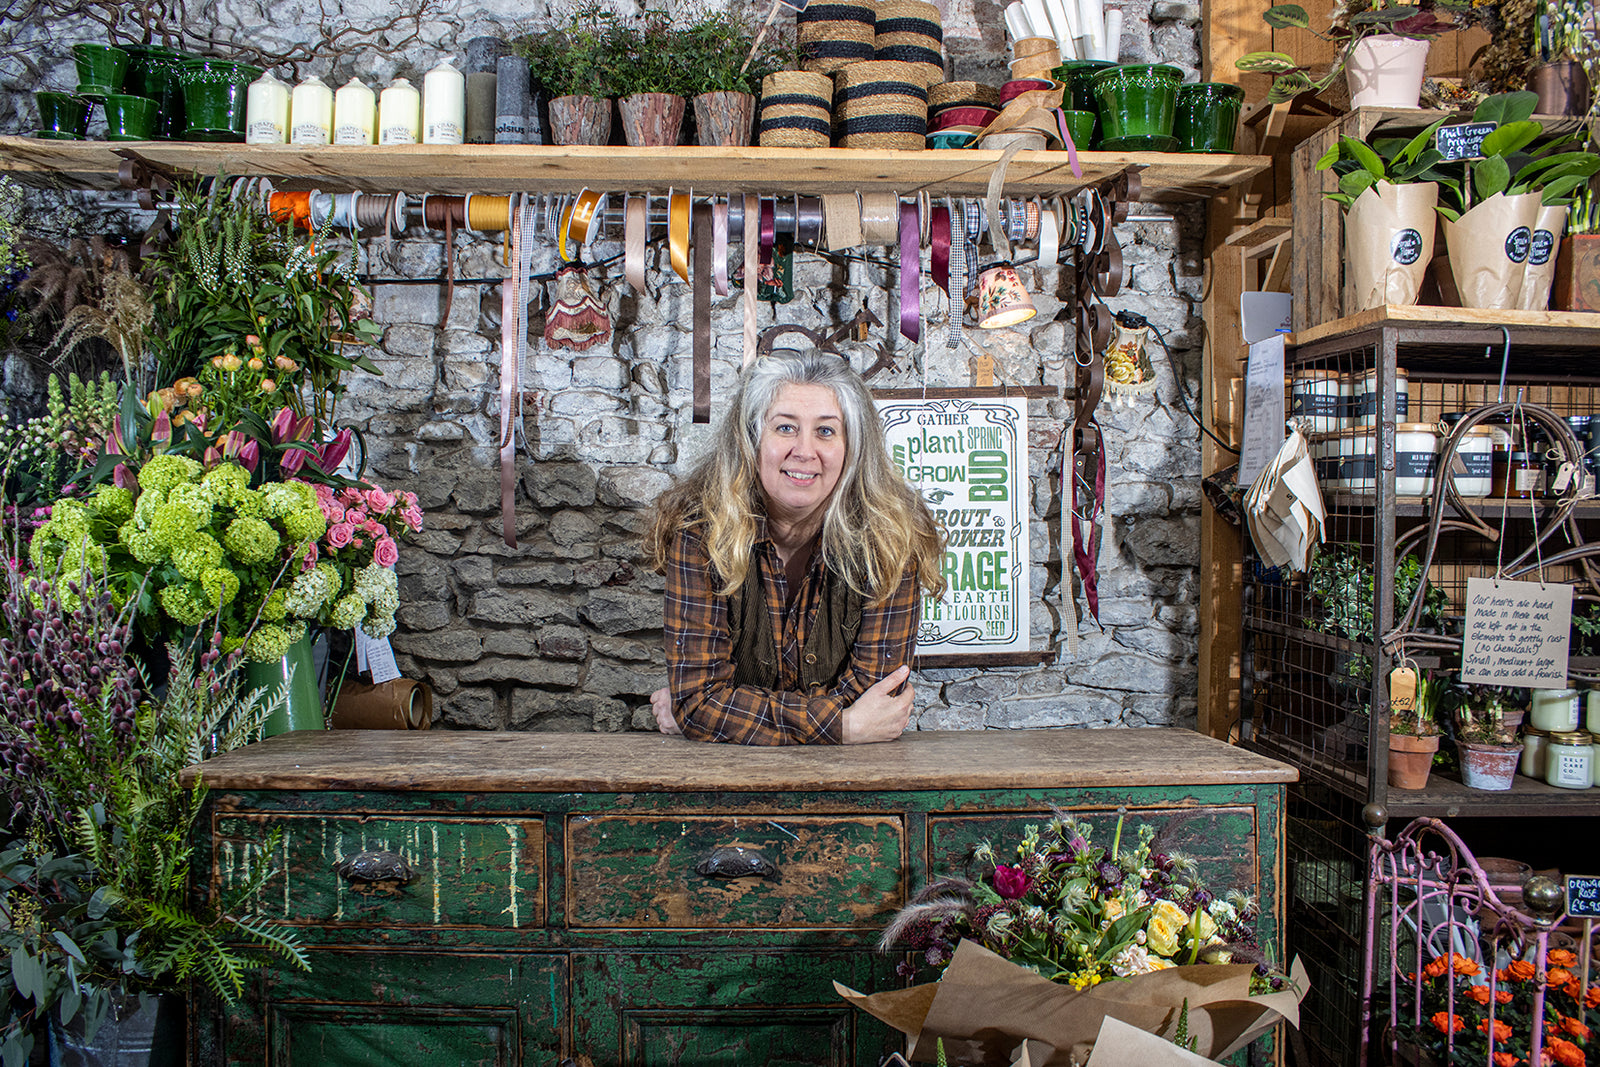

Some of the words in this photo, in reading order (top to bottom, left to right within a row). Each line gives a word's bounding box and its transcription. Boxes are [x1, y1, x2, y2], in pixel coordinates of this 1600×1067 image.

[1440, 126, 1461, 139] Phil
[1465, 126, 1495, 137] Green
[917, 413, 970, 425] GATHER
[907, 427, 965, 463] plant
[967, 426, 1003, 449] SPRING
[906, 465, 966, 482] GROW
[968, 450, 1008, 501] BUD
[931, 508, 992, 527] ROUT
[992, 515, 1006, 528] &
[939, 529, 1005, 547] OWER
[940, 551, 1009, 591] RAGE
[953, 591, 1009, 604] EARTH
[1472, 594, 1490, 605] Our
[1490, 597, 1514, 608] hearts
[1516, 600, 1530, 608] are
[1532, 599, 1554, 610] hand
[946, 605, 1010, 621] FLOURISH
[1500, 608, 1509, 618] in
[1533, 612, 1550, 621] and
[985, 621, 1005, 636] SEED
[1473, 621, 1486, 629] are
[1488, 620, 1502, 632] left
[1505, 623, 1518, 631] out
[1520, 623, 1527, 632] in
[1530, 622, 1542, 632] the
[1471, 632, 1505, 641] elements
[1508, 633, 1516, 641] to
[1515, 634, 1543, 647] gently
[1547, 635, 1566, 643] rust
[1478, 668, 1492, 677] can
[1494, 667, 1510, 677] also
[1511, 668, 1527, 677] add
[1578, 888, 1596, 899] ROSE
